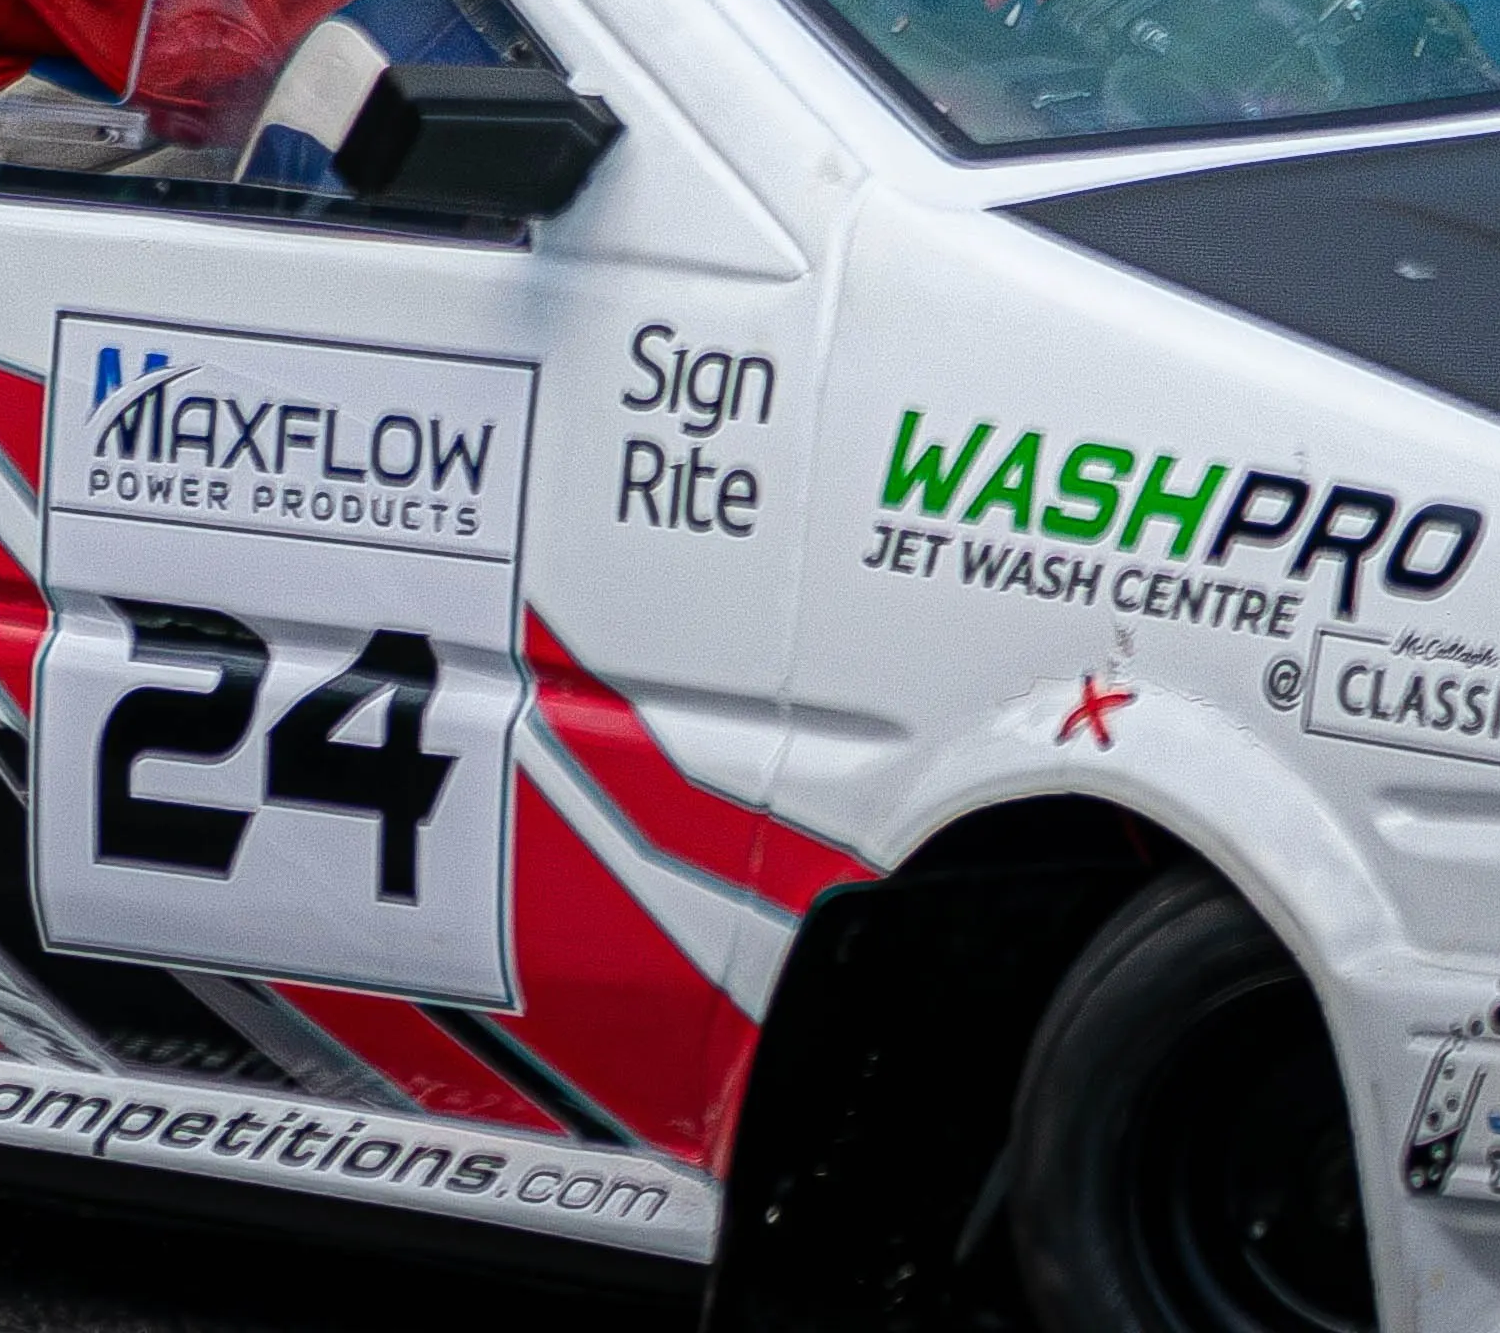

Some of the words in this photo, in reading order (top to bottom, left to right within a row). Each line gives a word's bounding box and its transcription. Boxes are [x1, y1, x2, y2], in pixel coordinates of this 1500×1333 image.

[90, 345, 498, 493] MAXFLOW
[620, 322, 778, 438] Sign
[87, 467, 233, 516] POWER
[250, 481, 484, 539] PRODUCTS
[616, 437, 763, 539] Rite
[879, 409, 1486, 620] WASHPRO
[863, 524, 953, 579] JET
[960, 539, 1105, 608] WASH
[1111, 567, 1305, 641] CENTRE
[1266, 658, 1303, 713] @
[91, 596, 470, 909] 24
